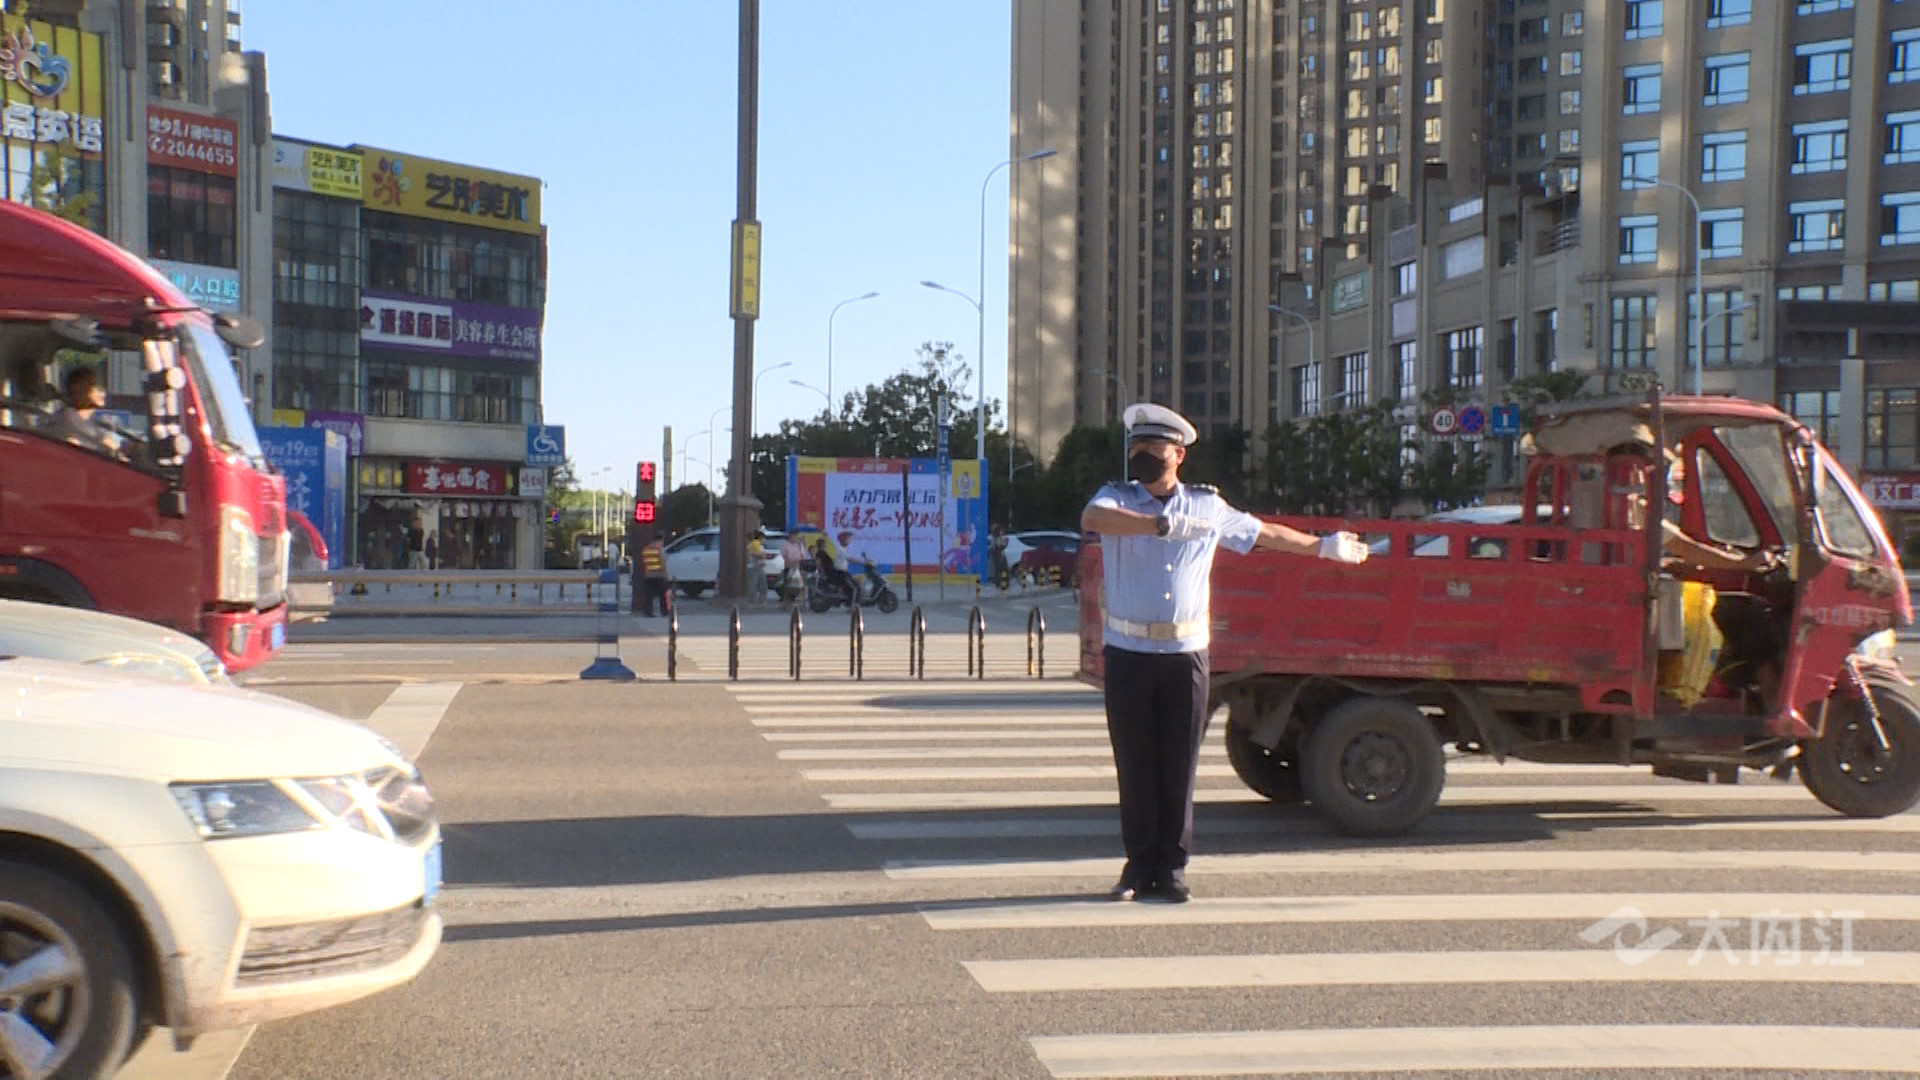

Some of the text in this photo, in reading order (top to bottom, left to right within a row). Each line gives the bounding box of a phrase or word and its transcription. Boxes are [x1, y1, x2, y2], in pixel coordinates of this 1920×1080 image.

[167, 139, 234, 165] 2044655
[1436, 415, 1453, 427] 40
[635, 502, 656, 522] 63
